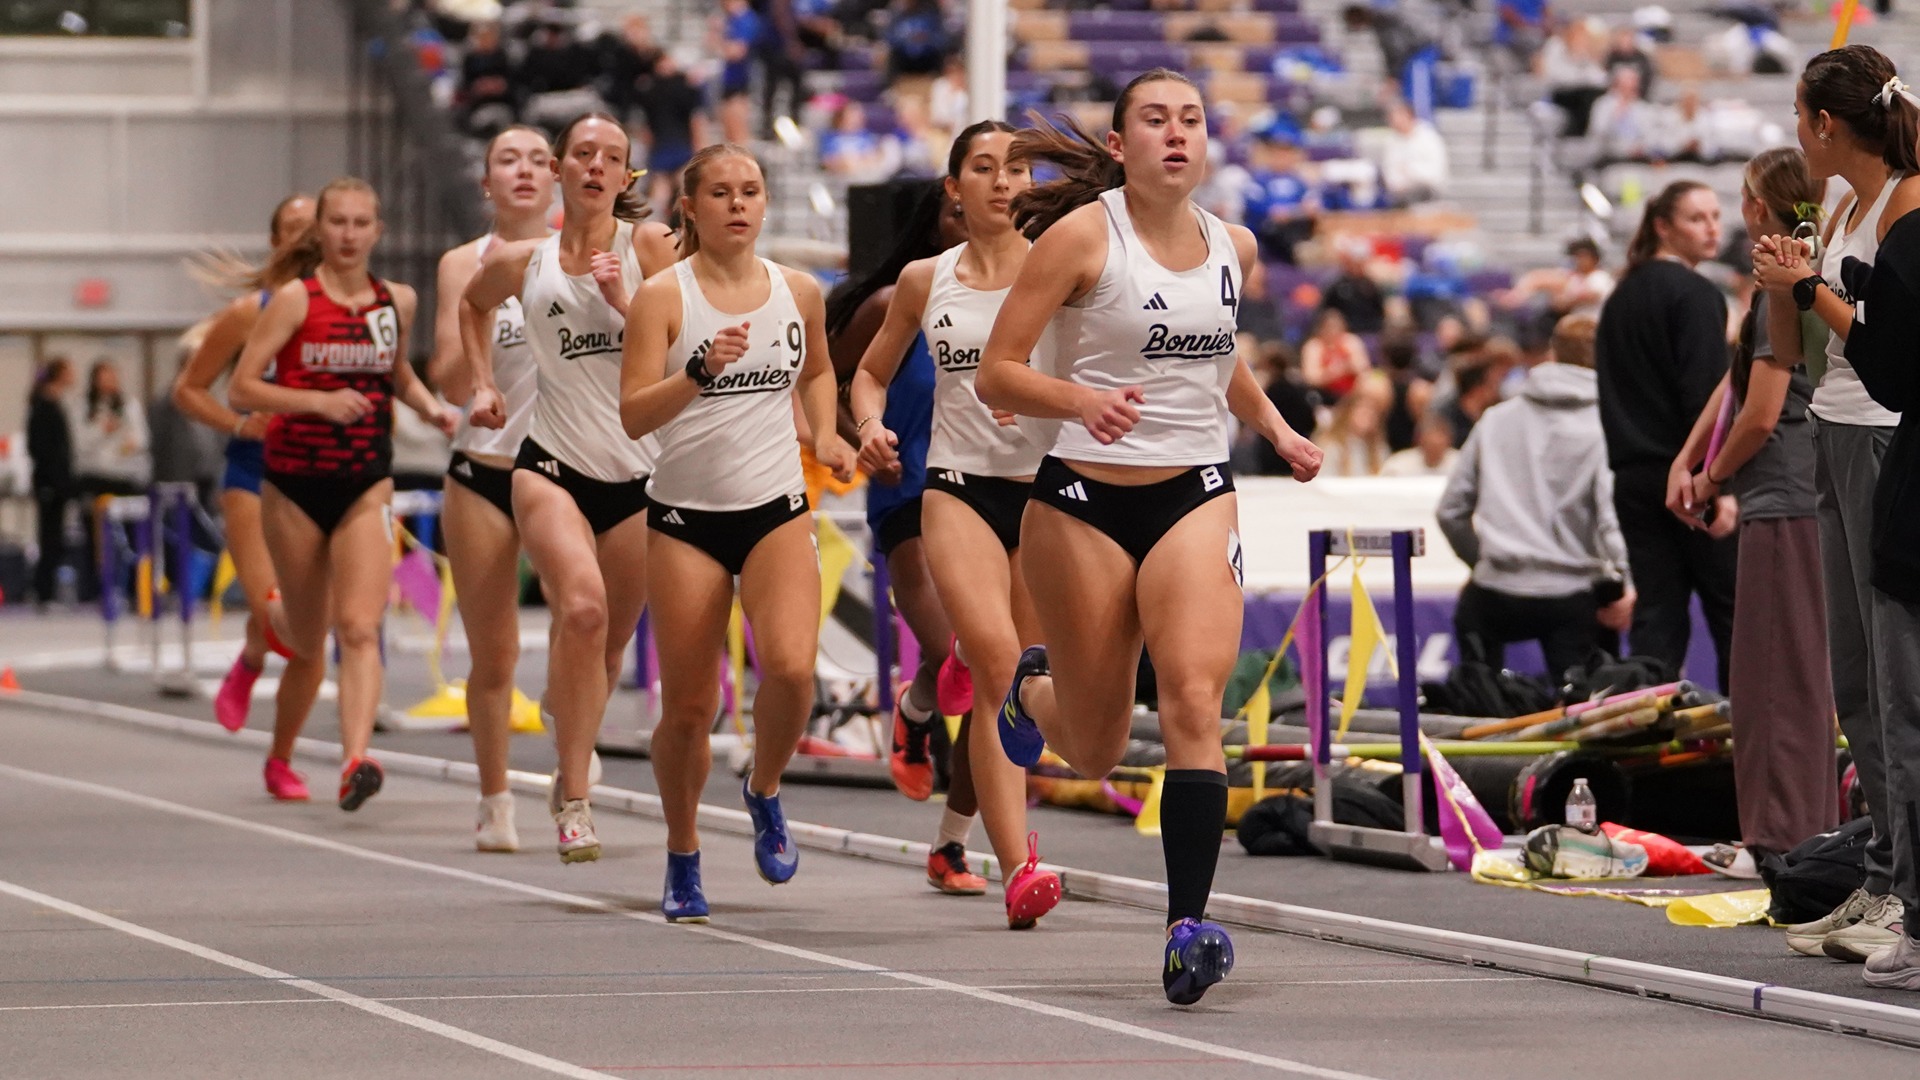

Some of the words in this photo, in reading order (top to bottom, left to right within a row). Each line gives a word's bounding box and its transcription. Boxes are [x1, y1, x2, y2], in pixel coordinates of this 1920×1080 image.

[1220, 265, 1237, 318] 4
[377, 311, 396, 347] 6
[786, 321, 802, 369] 9
[1140, 323, 1235, 360] Bonnies
[1200, 465, 1224, 492] B
